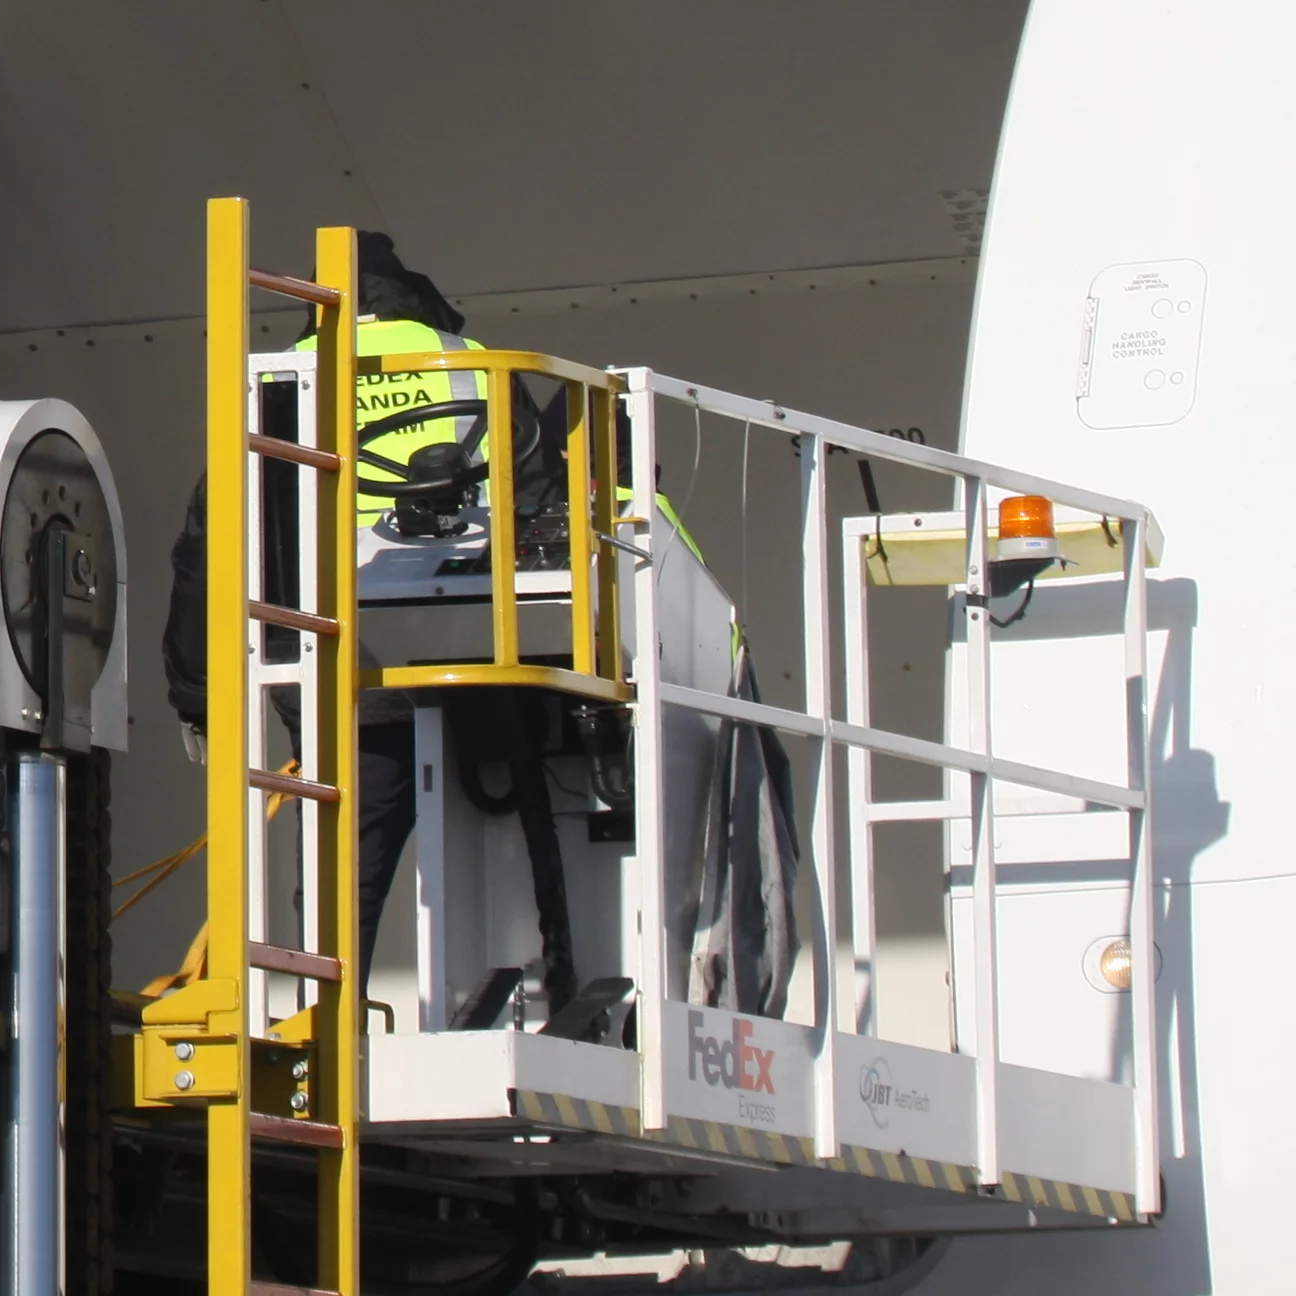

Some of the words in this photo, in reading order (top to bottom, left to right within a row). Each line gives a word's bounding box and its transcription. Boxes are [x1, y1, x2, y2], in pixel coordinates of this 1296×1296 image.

[1111, 337, 1166, 350] HANDLING
[1120, 329, 1159, 341] CARGO
[1111, 347, 1164, 359] CONTROL
[356, 389, 434, 412] ANDA
[687, 1009, 776, 1096] FedEx
[872, 1083, 892, 1106] JBT
[738, 1094, 776, 1124] Express
